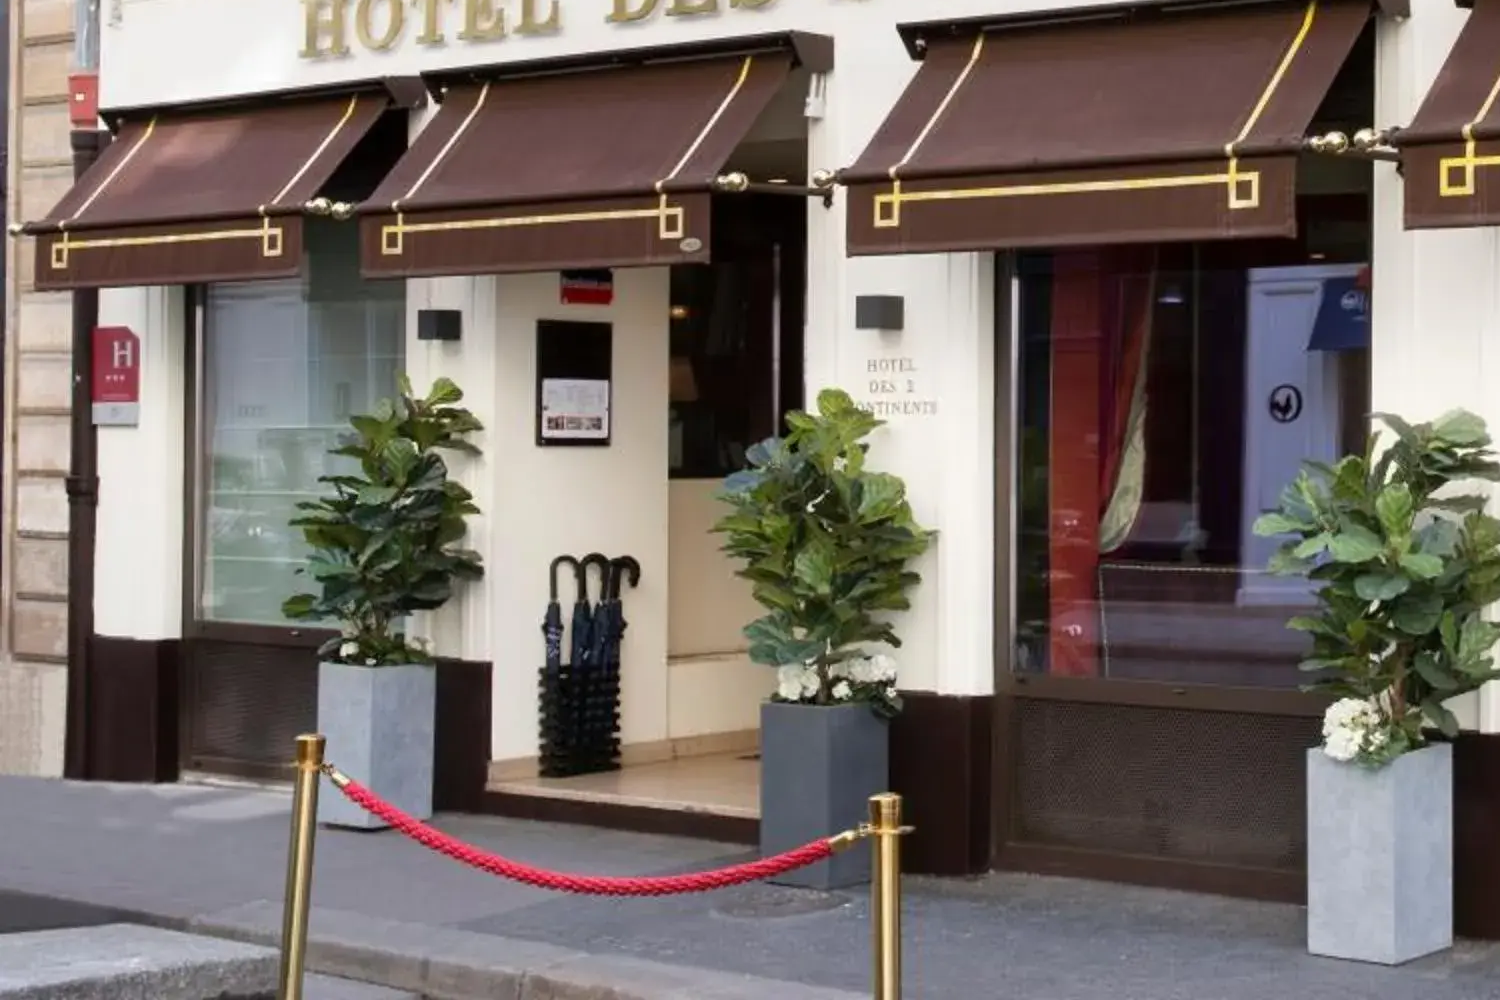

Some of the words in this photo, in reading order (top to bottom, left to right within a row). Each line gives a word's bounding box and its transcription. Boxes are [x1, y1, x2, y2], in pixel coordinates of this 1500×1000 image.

[113, 340, 133, 369] H
[867, 357, 918, 373] HOTEL
[869, 379, 897, 394] DES
[854, 401, 938, 416] ONTINENTS
